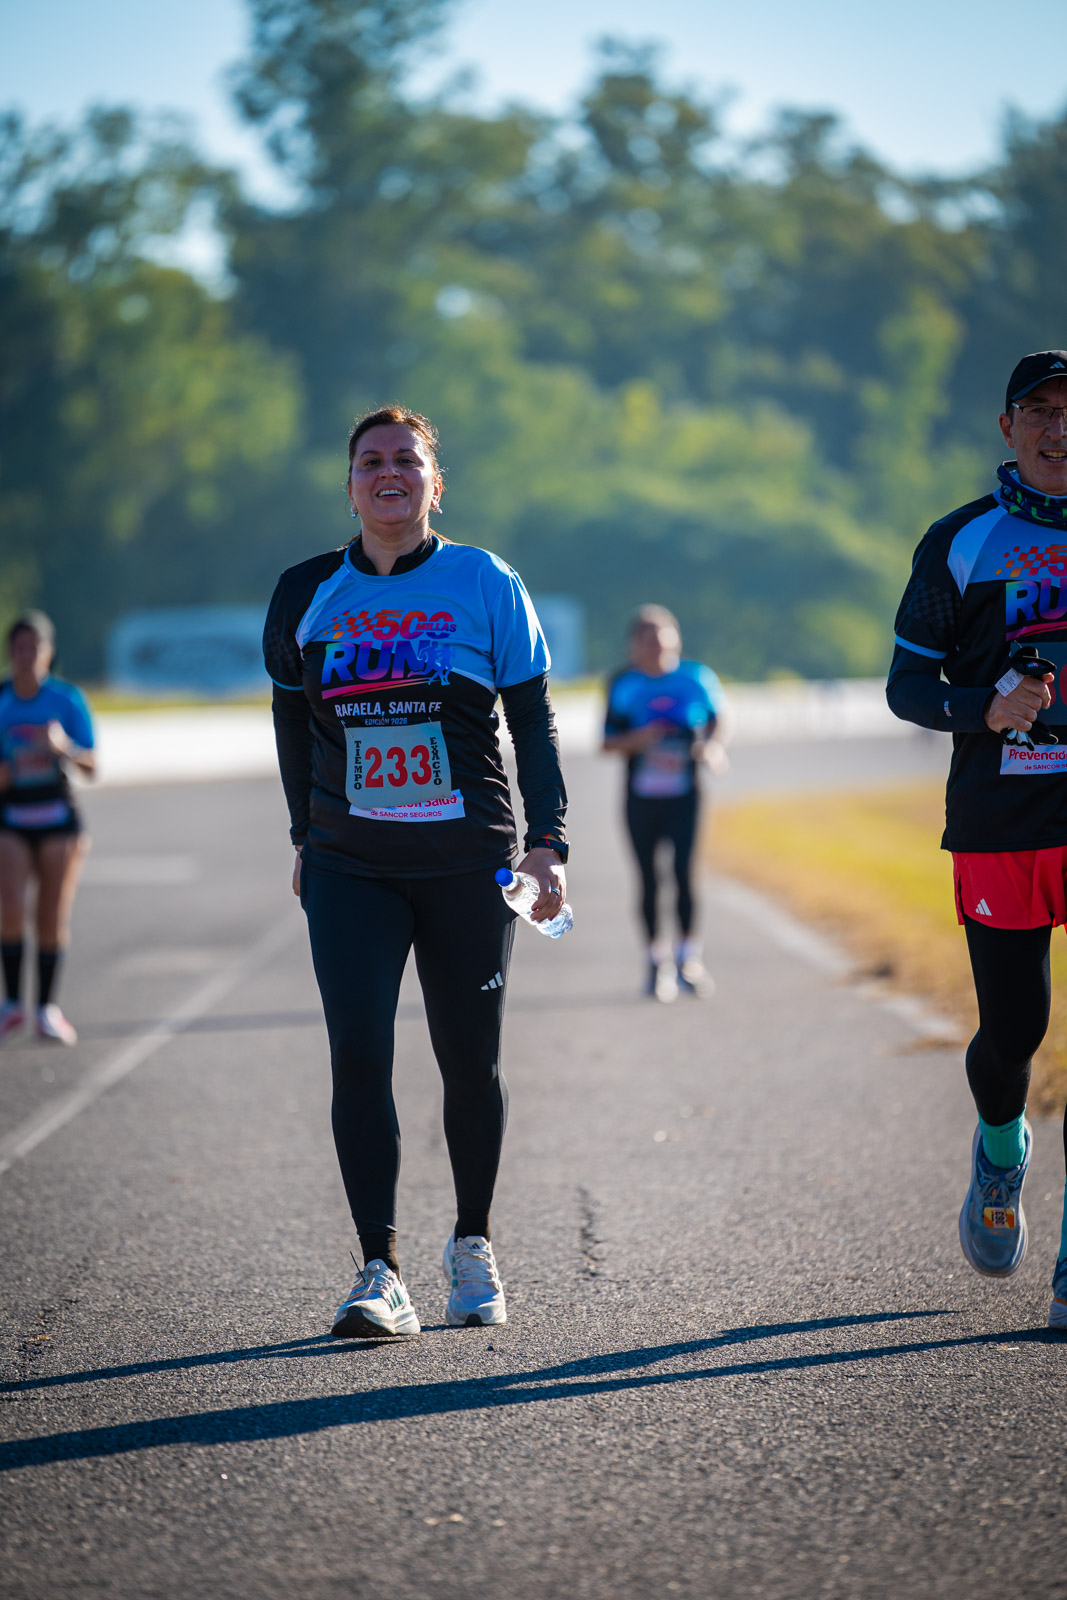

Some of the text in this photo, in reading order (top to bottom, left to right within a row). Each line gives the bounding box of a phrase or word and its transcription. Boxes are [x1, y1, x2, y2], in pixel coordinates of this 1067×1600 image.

[372, 610, 453, 640] 500
[416, 622, 457, 632] MILLAS
[334, 701, 442, 717] RAFAELA, SANTA FE
[365, 717, 390, 726] EDICIÓN
[429, 737, 442, 785] EXACTO
[1008, 748, 1067, 760] Prevenció
[354, 740, 363, 790] TIEMPO
[364, 744, 432, 788] 233
[409, 810, 442, 818] SEGUROS
